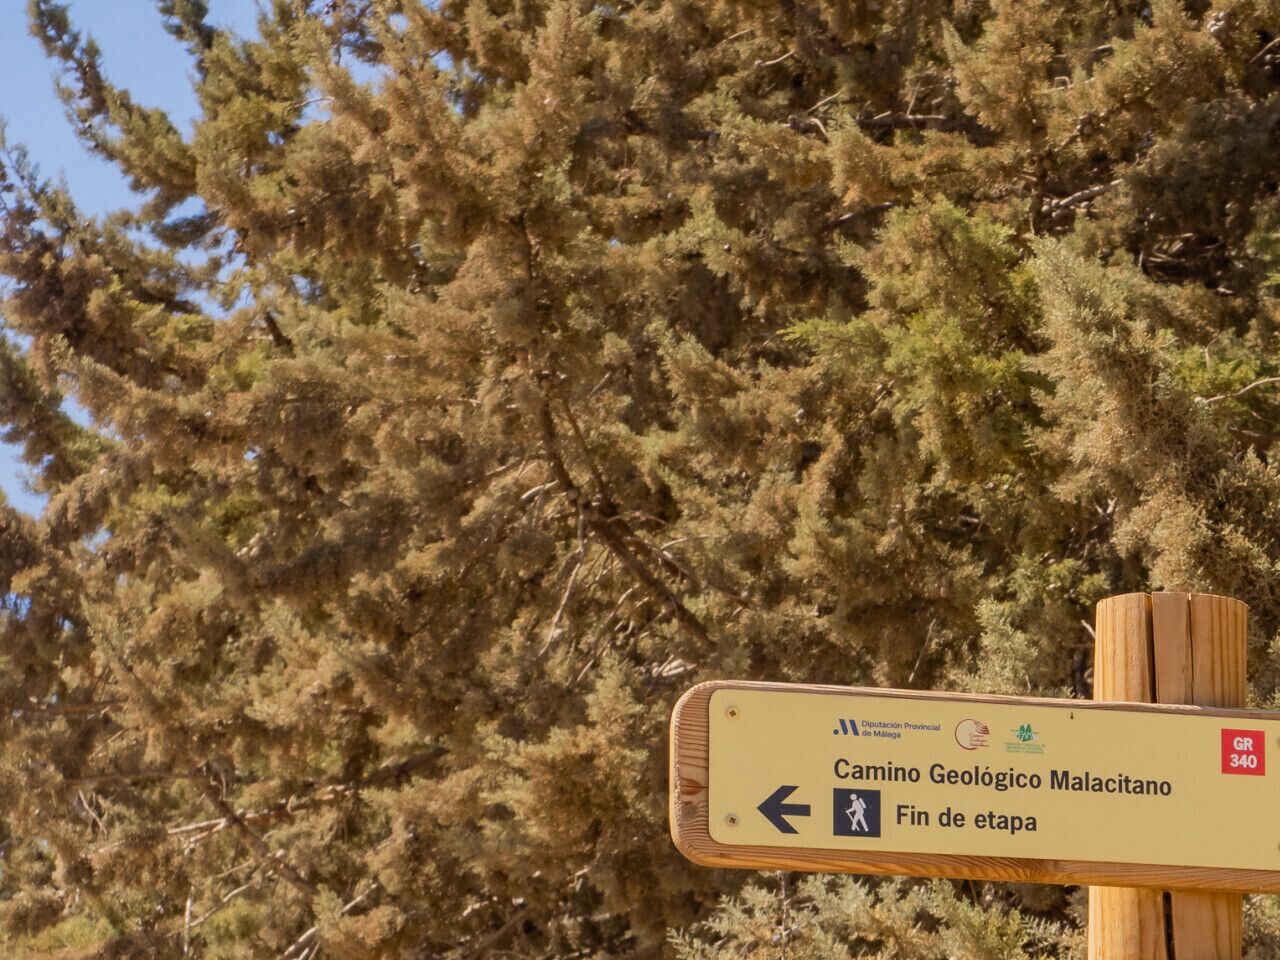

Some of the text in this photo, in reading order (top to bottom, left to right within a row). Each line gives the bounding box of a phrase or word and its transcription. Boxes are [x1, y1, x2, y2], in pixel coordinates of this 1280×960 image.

[861, 720, 941, 731] Diputación Provincial
[873, 729, 901, 739] Málaga
[1232, 736, 1254, 751] GR
[1230, 754, 1257, 769] 340
[834, 758, 1172, 796] Camino Geológico Malacitano
[896, 804, 1038, 835] Fin de etapa
